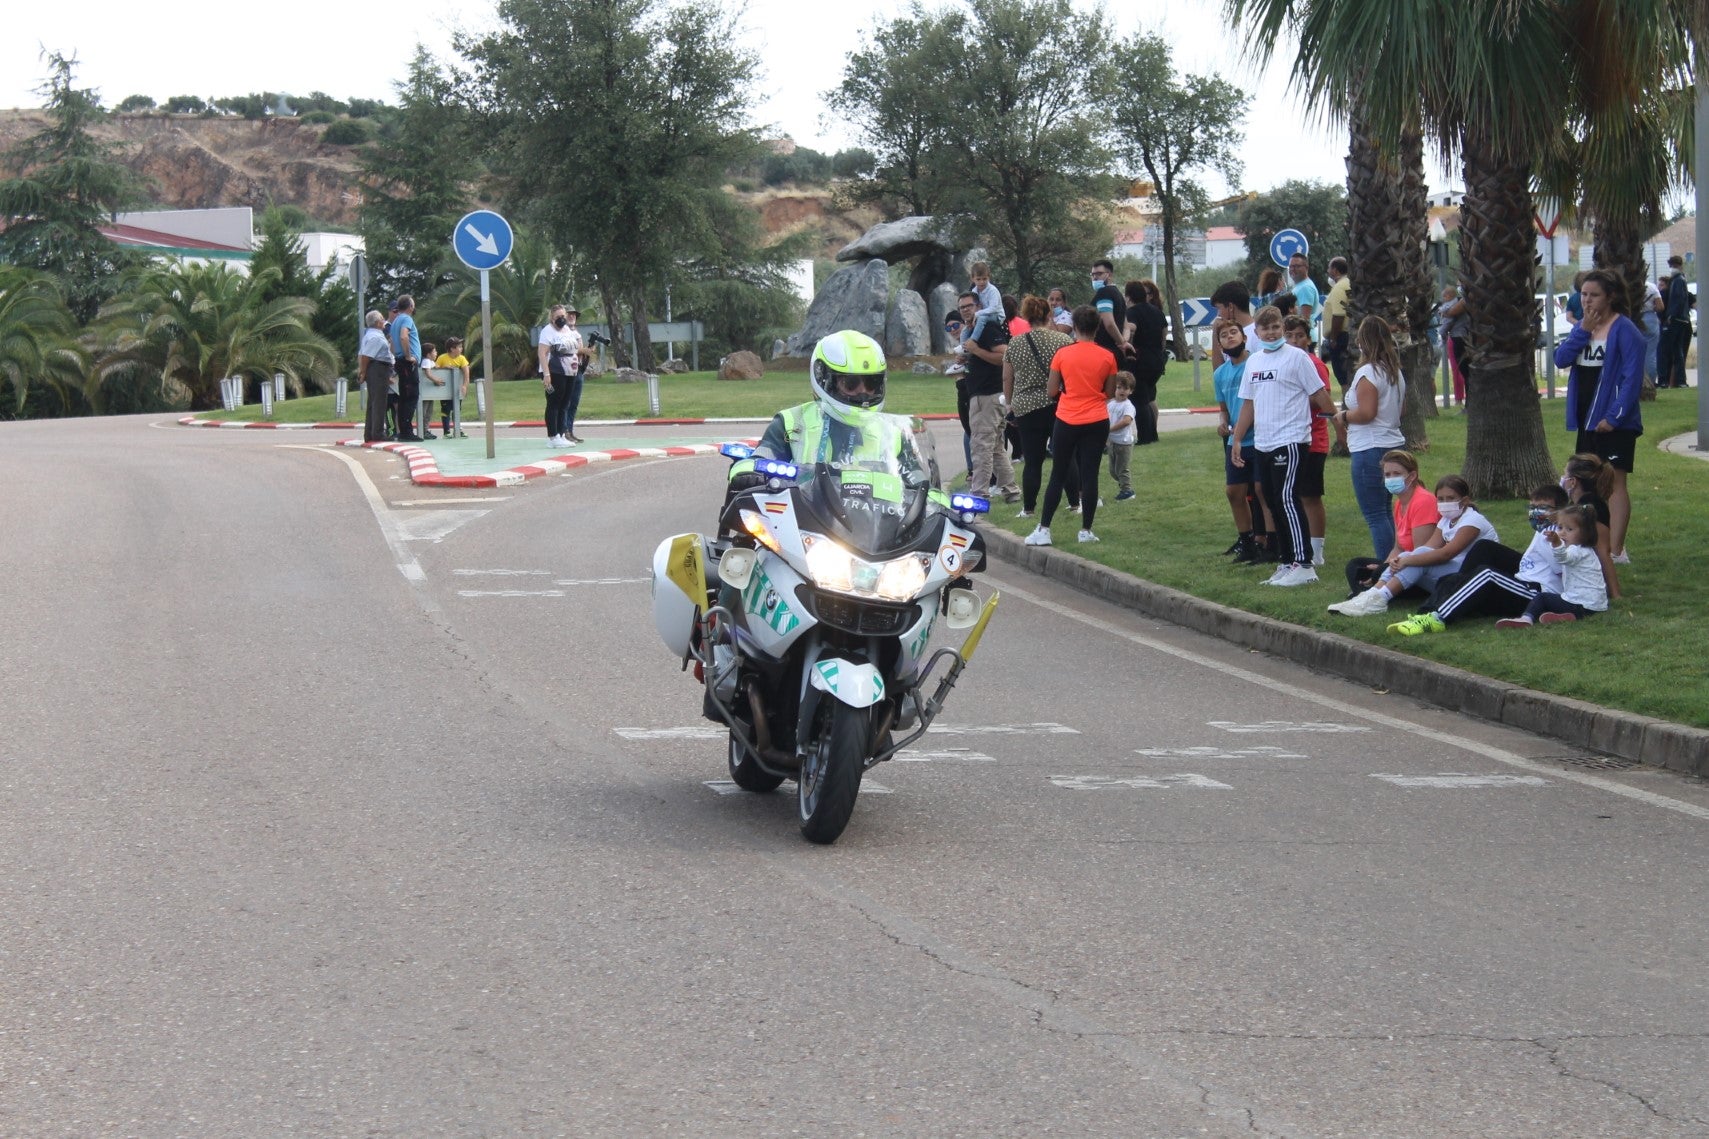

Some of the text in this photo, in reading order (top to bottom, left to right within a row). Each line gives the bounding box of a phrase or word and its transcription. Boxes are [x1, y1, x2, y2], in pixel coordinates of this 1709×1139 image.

[1583, 345, 1605, 360] ILA
[1251, 371, 1274, 381] FILA
[947, 554, 954, 566] 4
